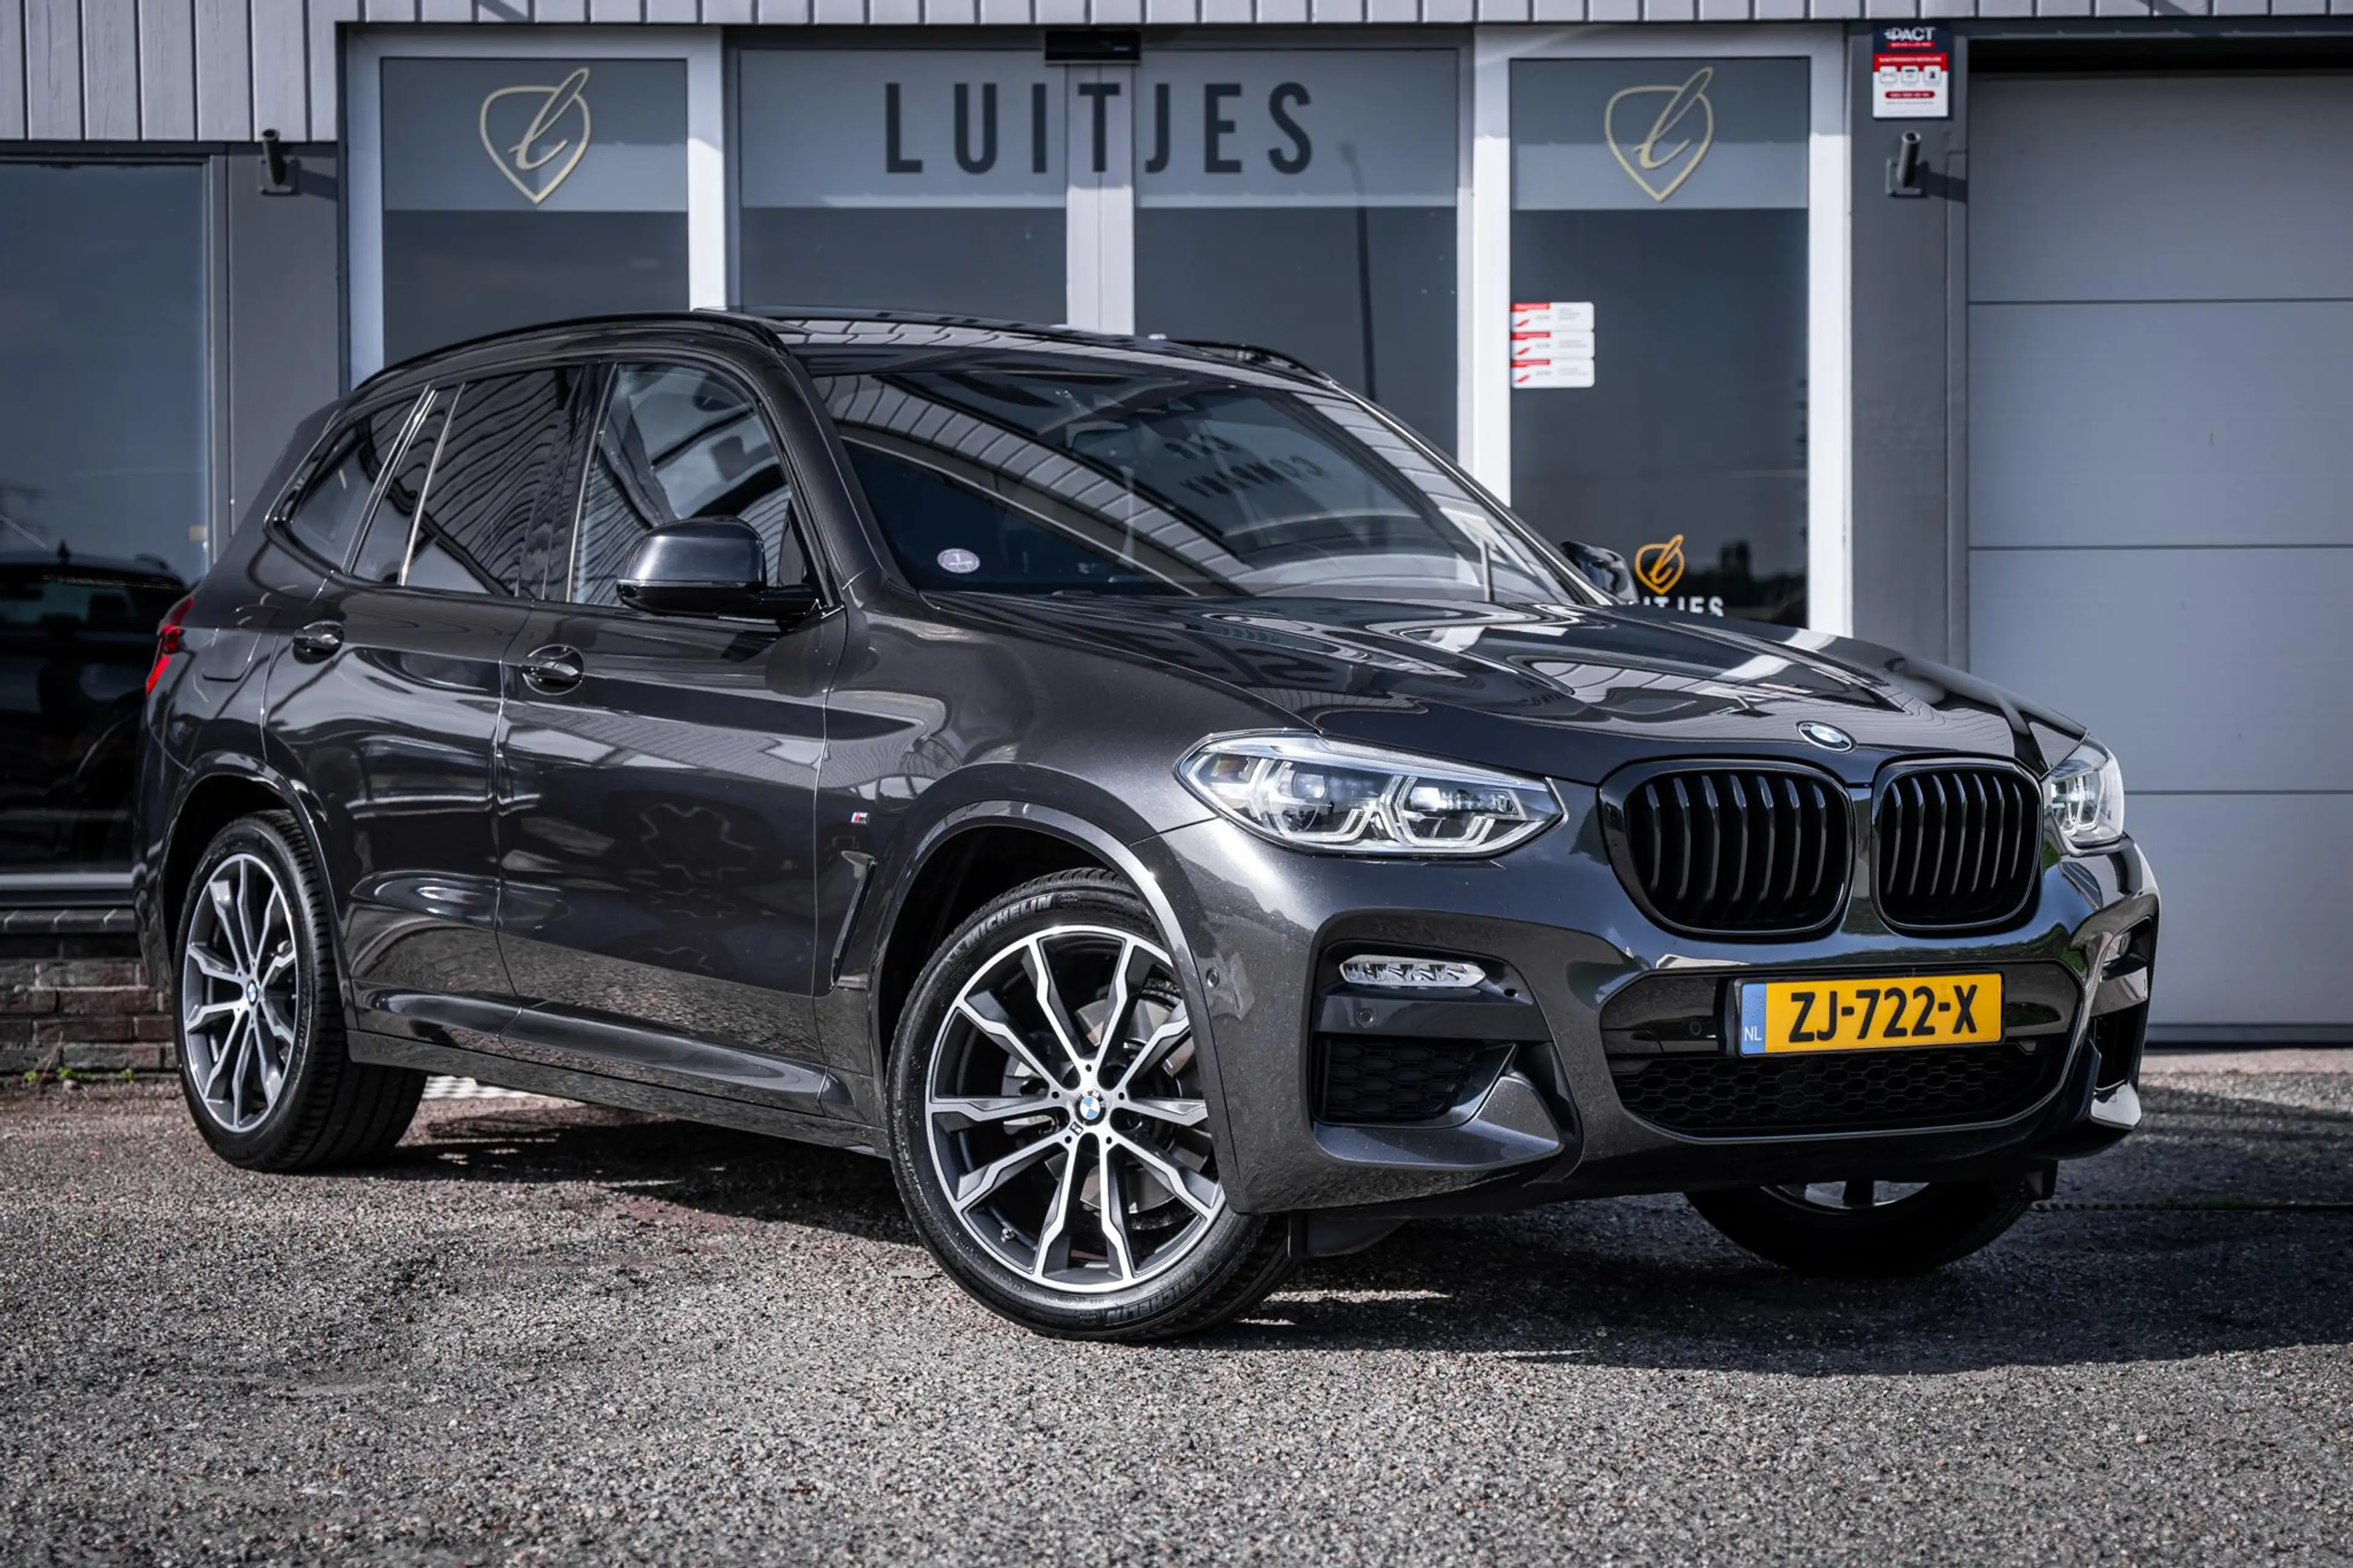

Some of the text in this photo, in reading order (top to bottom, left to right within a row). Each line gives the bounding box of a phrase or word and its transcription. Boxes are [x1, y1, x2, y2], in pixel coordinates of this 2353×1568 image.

[885, 82, 1313, 175] LUITJES
[964, 893, 1053, 948] MICHELIN
[1745, 1026, 1762, 1041] NL
[1789, 985, 1977, 1042] ZJ-722-X
